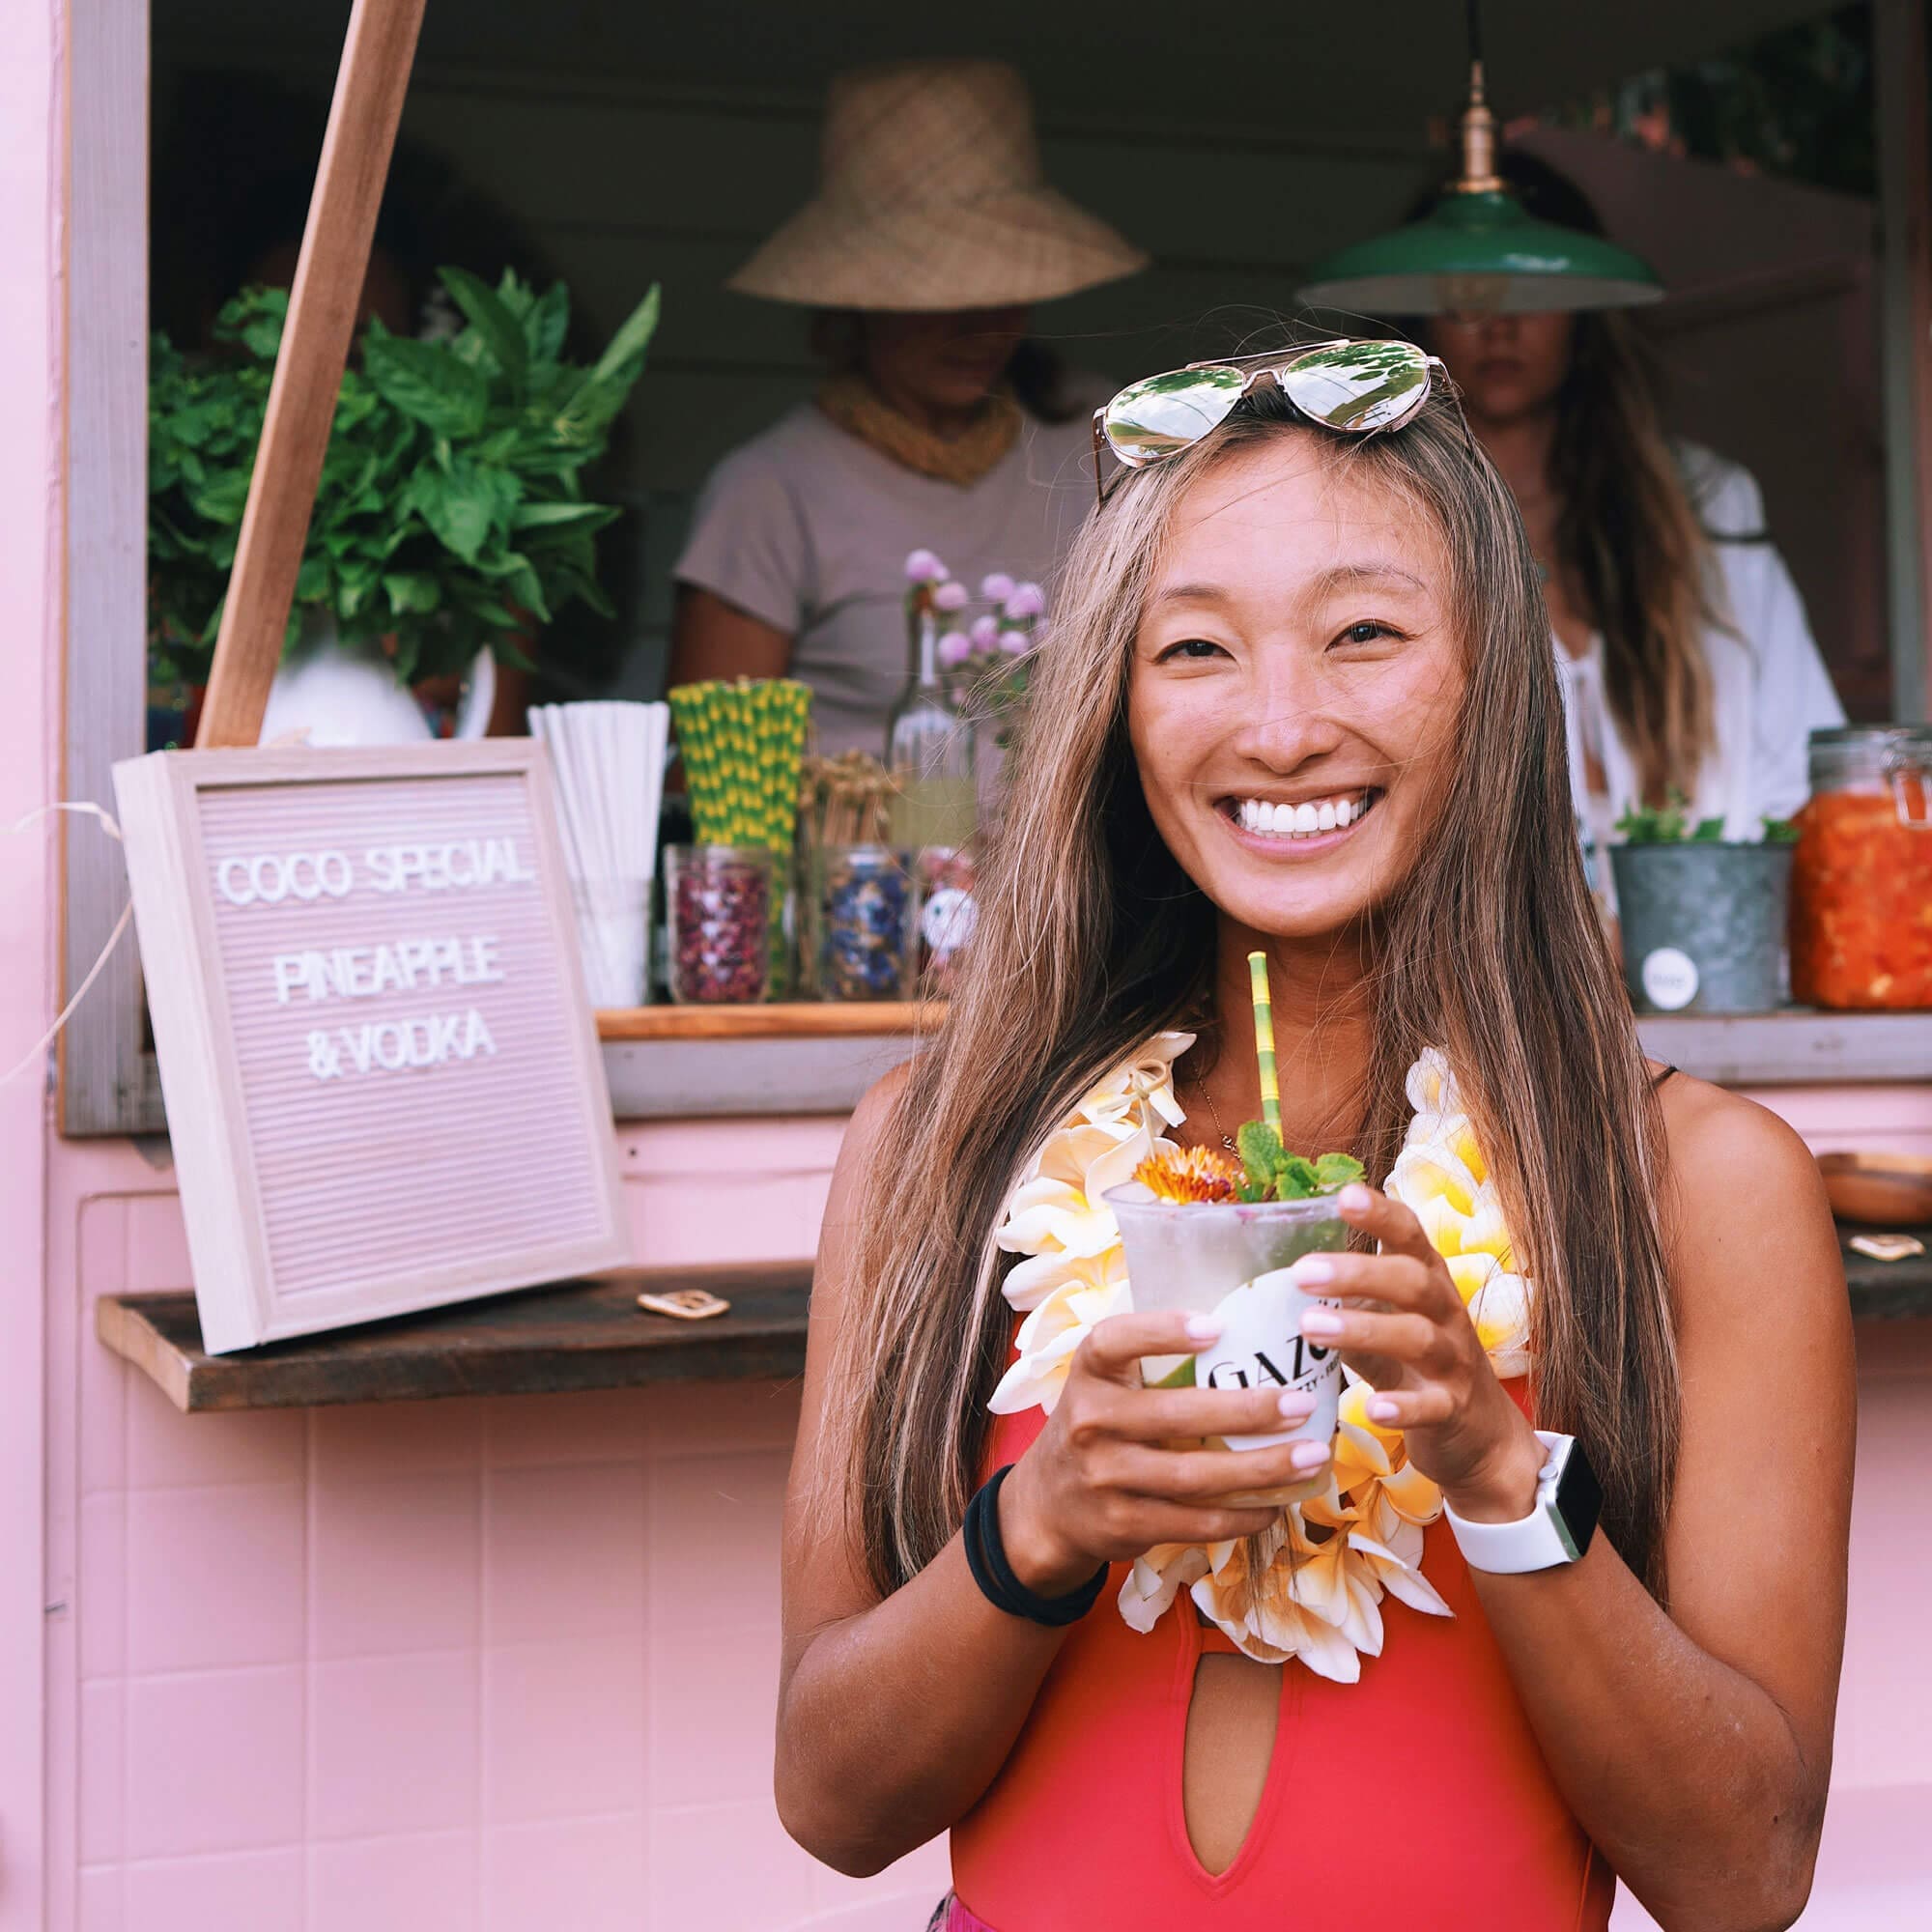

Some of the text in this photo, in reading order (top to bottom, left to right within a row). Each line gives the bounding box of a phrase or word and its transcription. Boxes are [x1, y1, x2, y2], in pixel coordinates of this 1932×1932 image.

[217, 837, 534, 905] COCO SPECIAL
[273, 936, 505, 1004] PINEAPPLE
